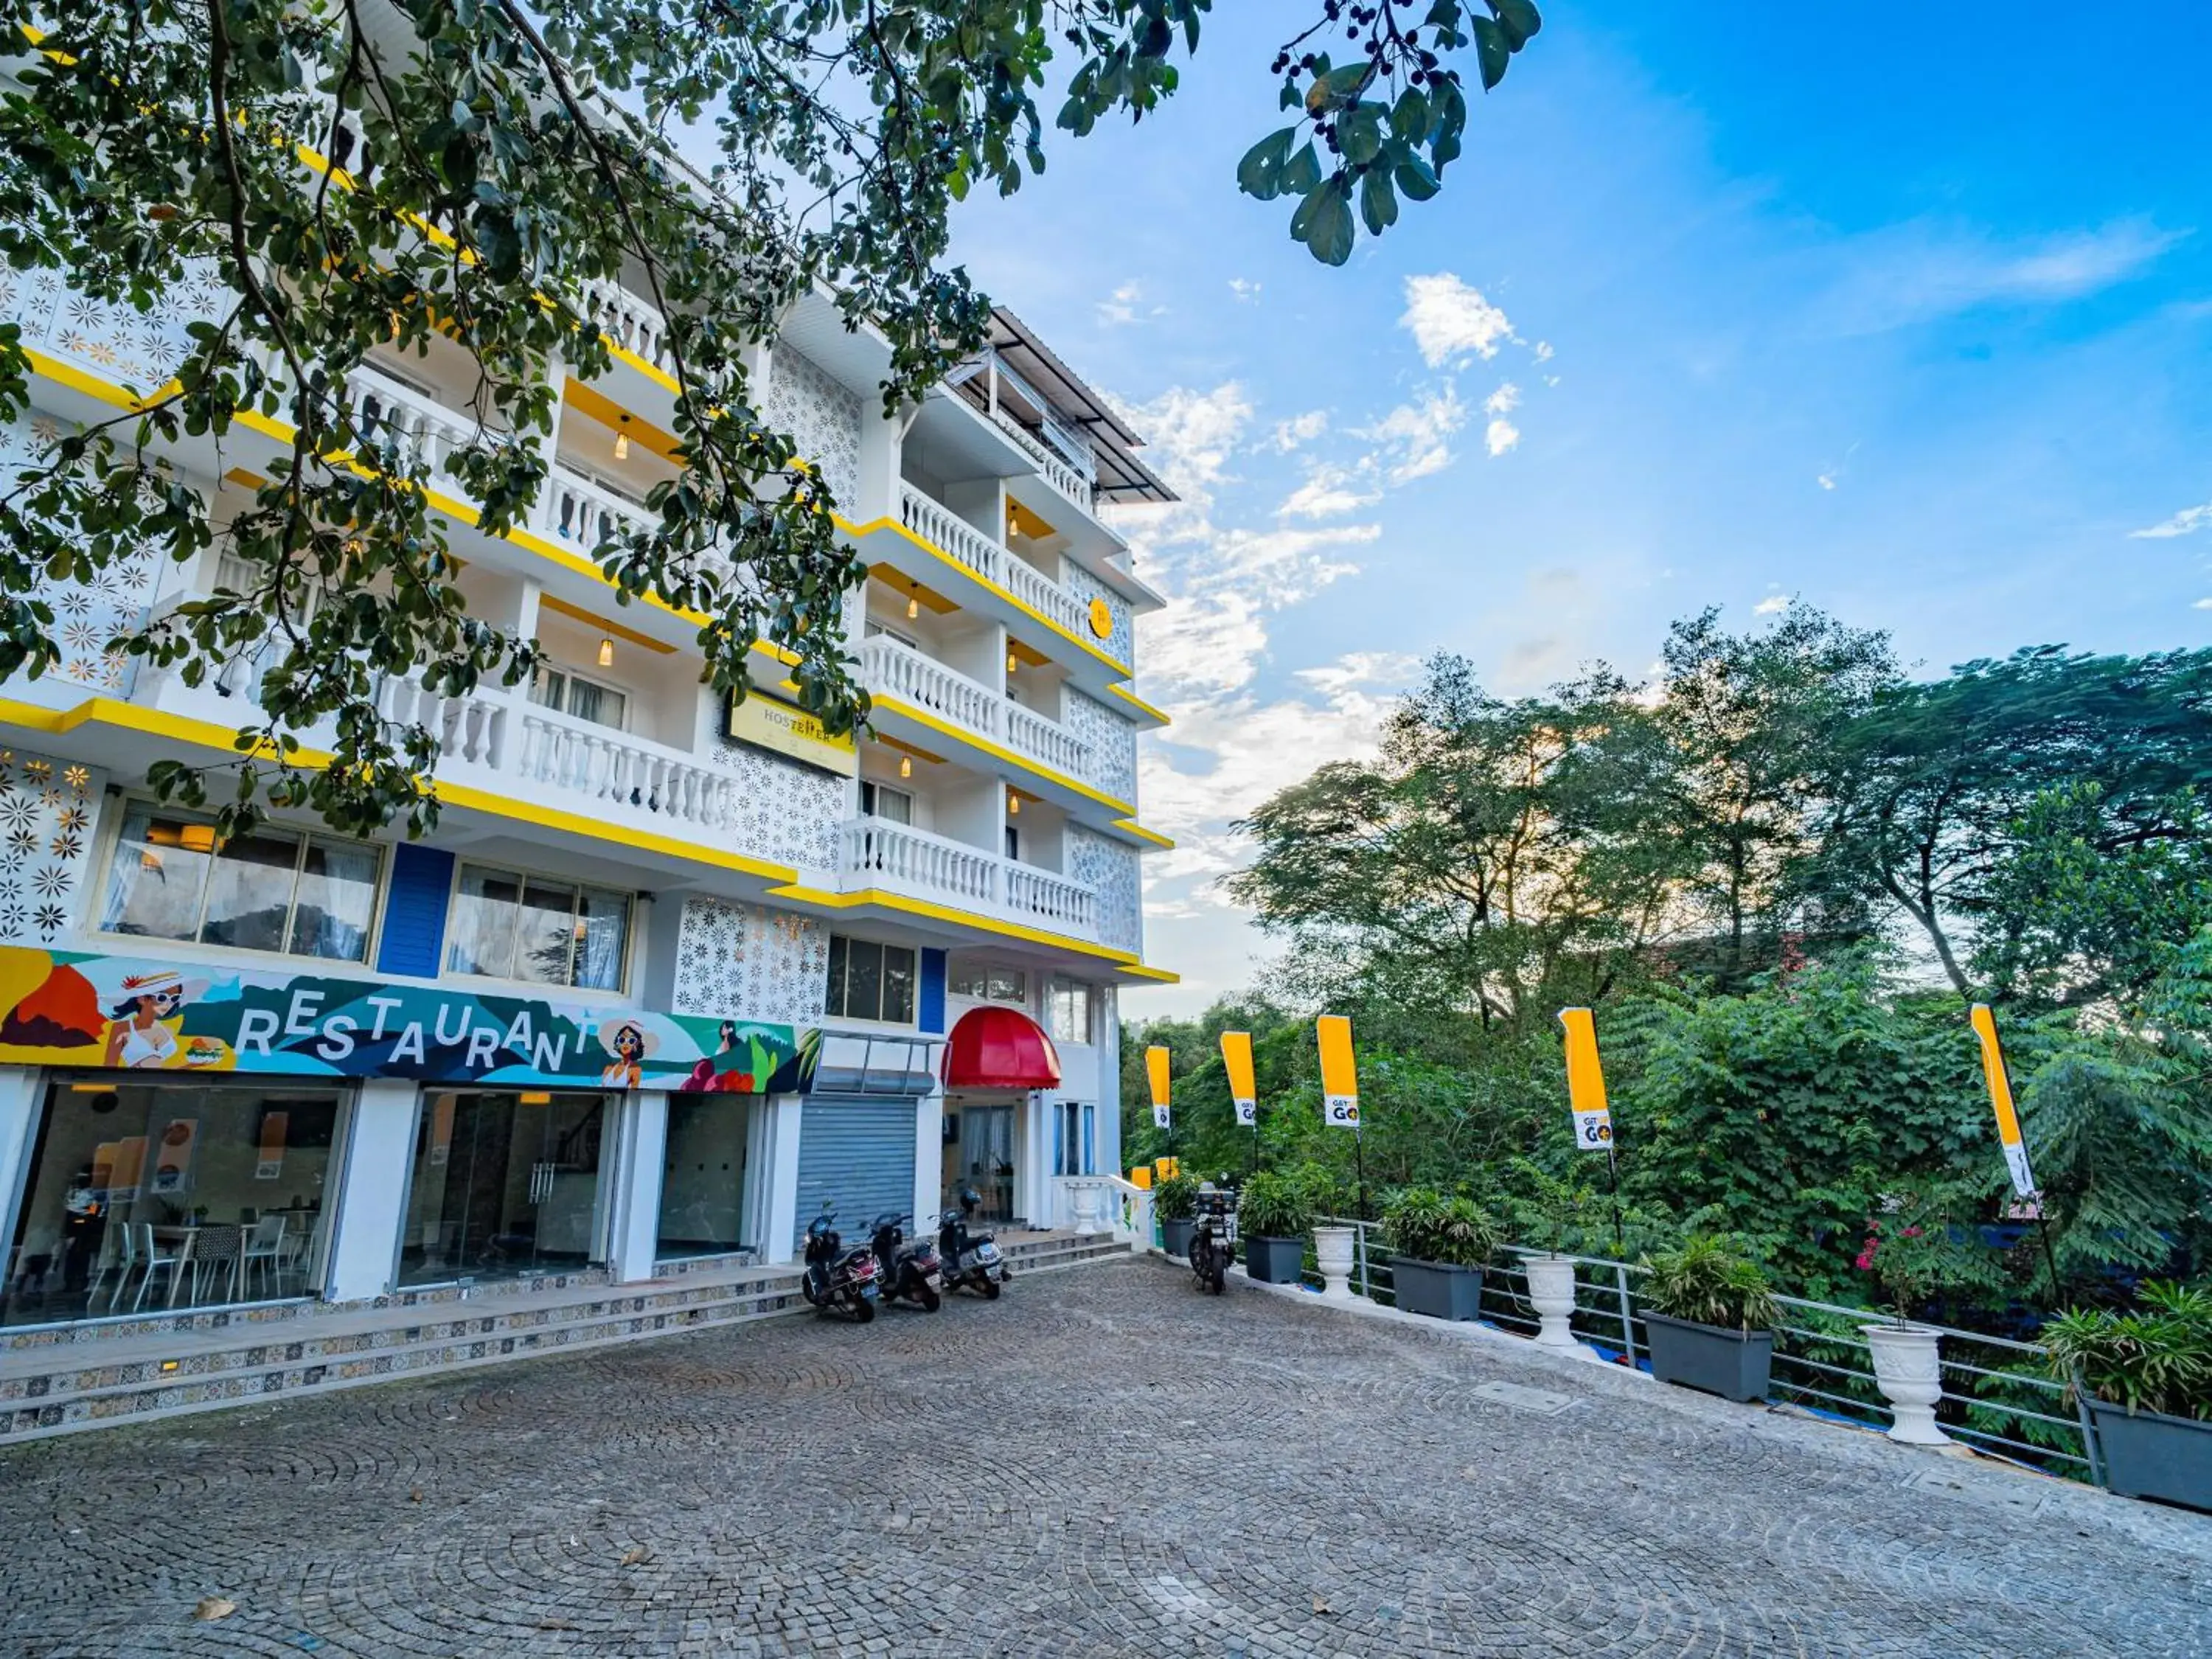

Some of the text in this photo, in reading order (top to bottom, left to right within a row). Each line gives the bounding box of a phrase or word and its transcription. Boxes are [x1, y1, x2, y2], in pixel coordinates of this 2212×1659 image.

[235, 990, 599, 1071] RESTAURANT
[1333, 1107, 1357, 1120] GO
[1585, 1125, 1611, 1142] GO
